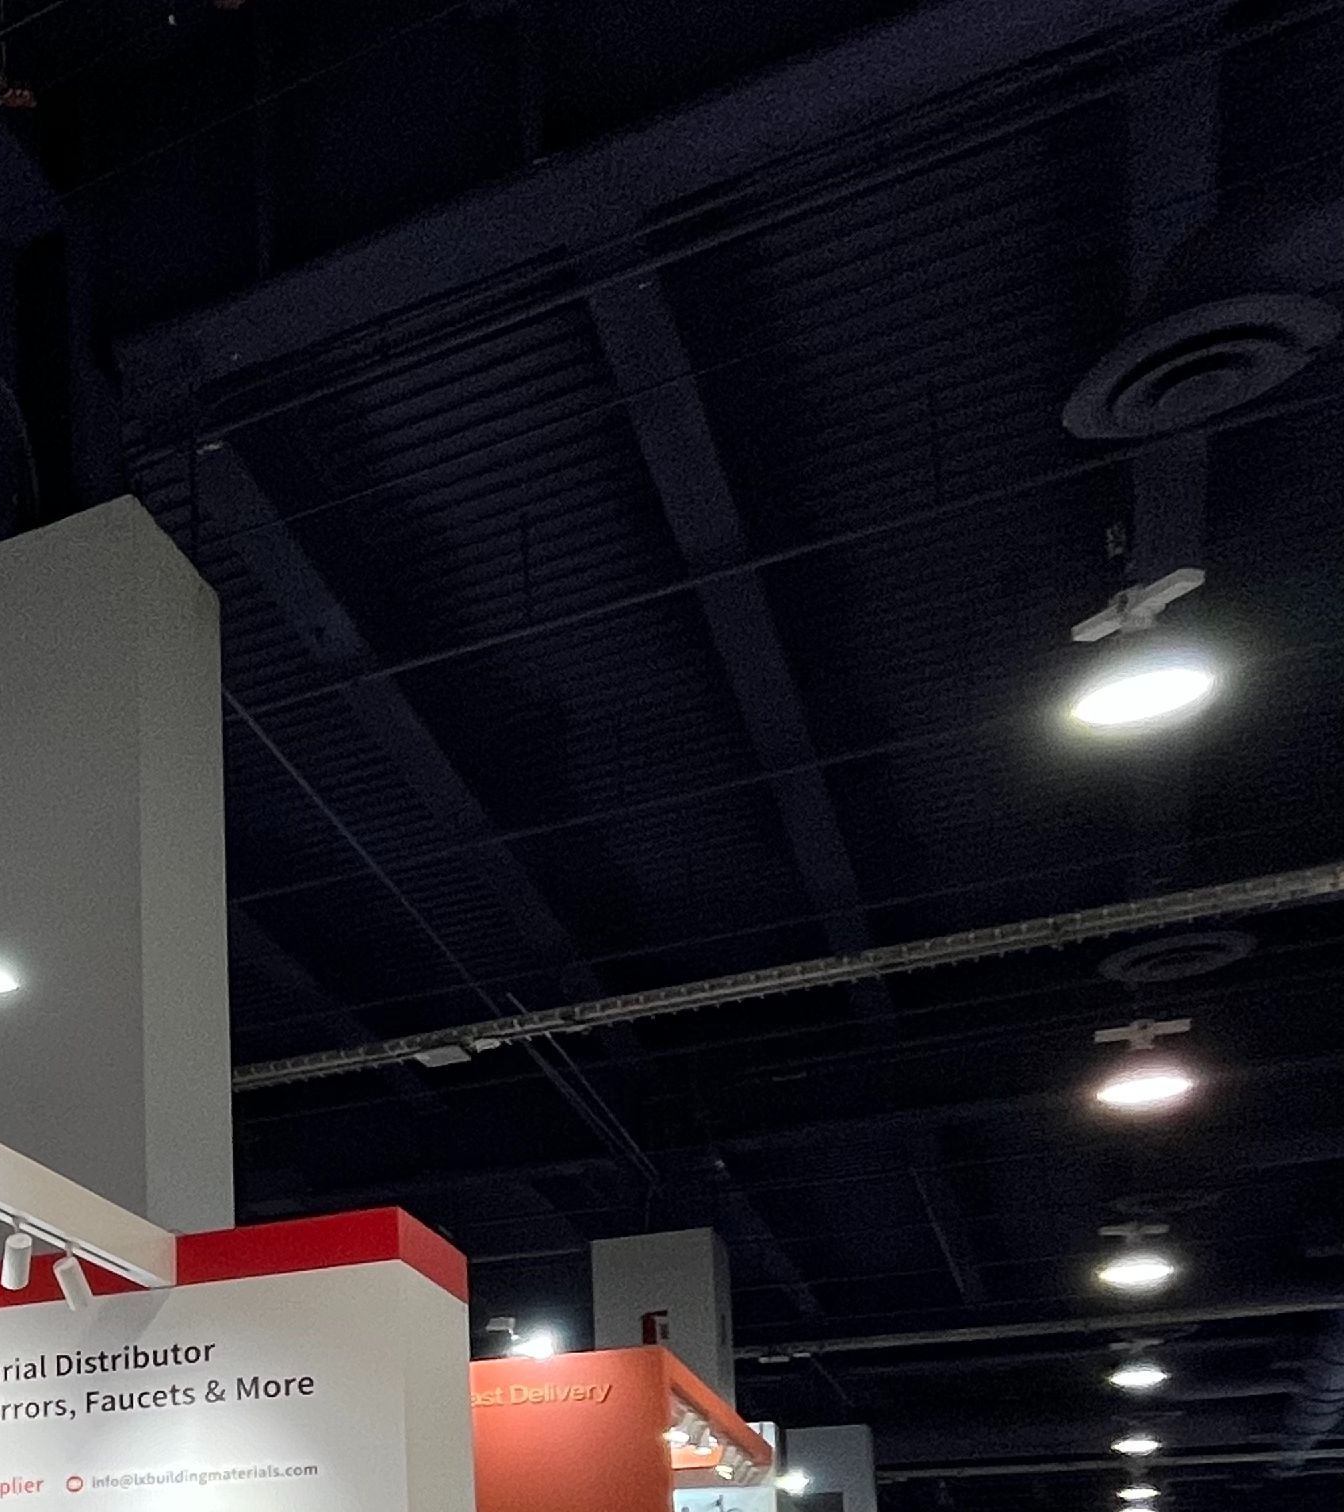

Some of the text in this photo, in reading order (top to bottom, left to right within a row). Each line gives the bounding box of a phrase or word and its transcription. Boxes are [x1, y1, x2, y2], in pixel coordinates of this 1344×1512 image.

[55, 1341, 217, 1378] Distributor
[85, 1383, 196, 1415] Faucets
[204, 1378, 227, 1403] &
[236, 1374, 316, 1401] More
[509, 1382, 613, 1406] Delivery
[91, 1463, 319, 1490] info@lxbuildingmaterials.com
